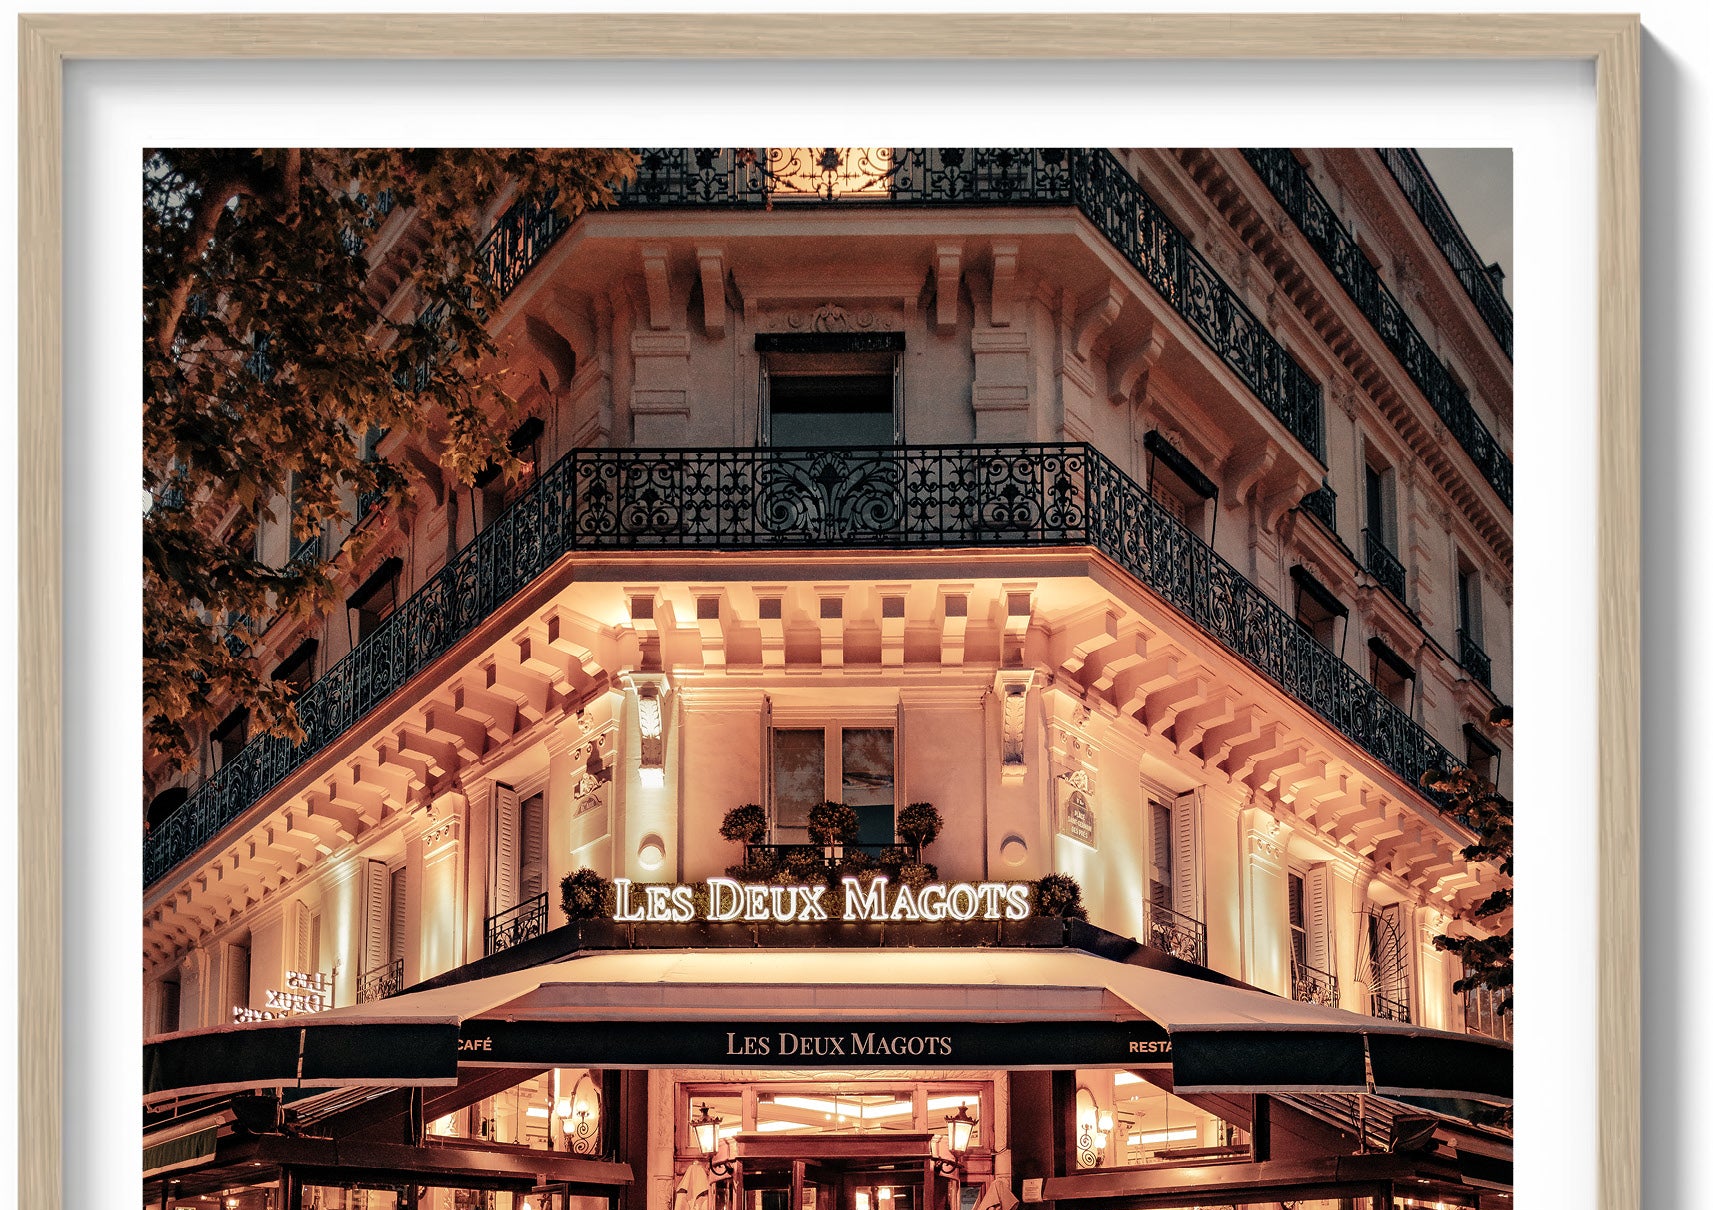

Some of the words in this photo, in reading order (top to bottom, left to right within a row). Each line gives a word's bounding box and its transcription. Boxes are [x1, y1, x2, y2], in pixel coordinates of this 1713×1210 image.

[613, 877, 694, 922] LES
[706, 877, 828, 922] DEUX
[841, 876, 1029, 921] MAGOTS
[726, 1032, 770, 1056] LES
[778, 1032, 845, 1056] DEUX
[850, 1032, 952, 1056] MAGOTS
